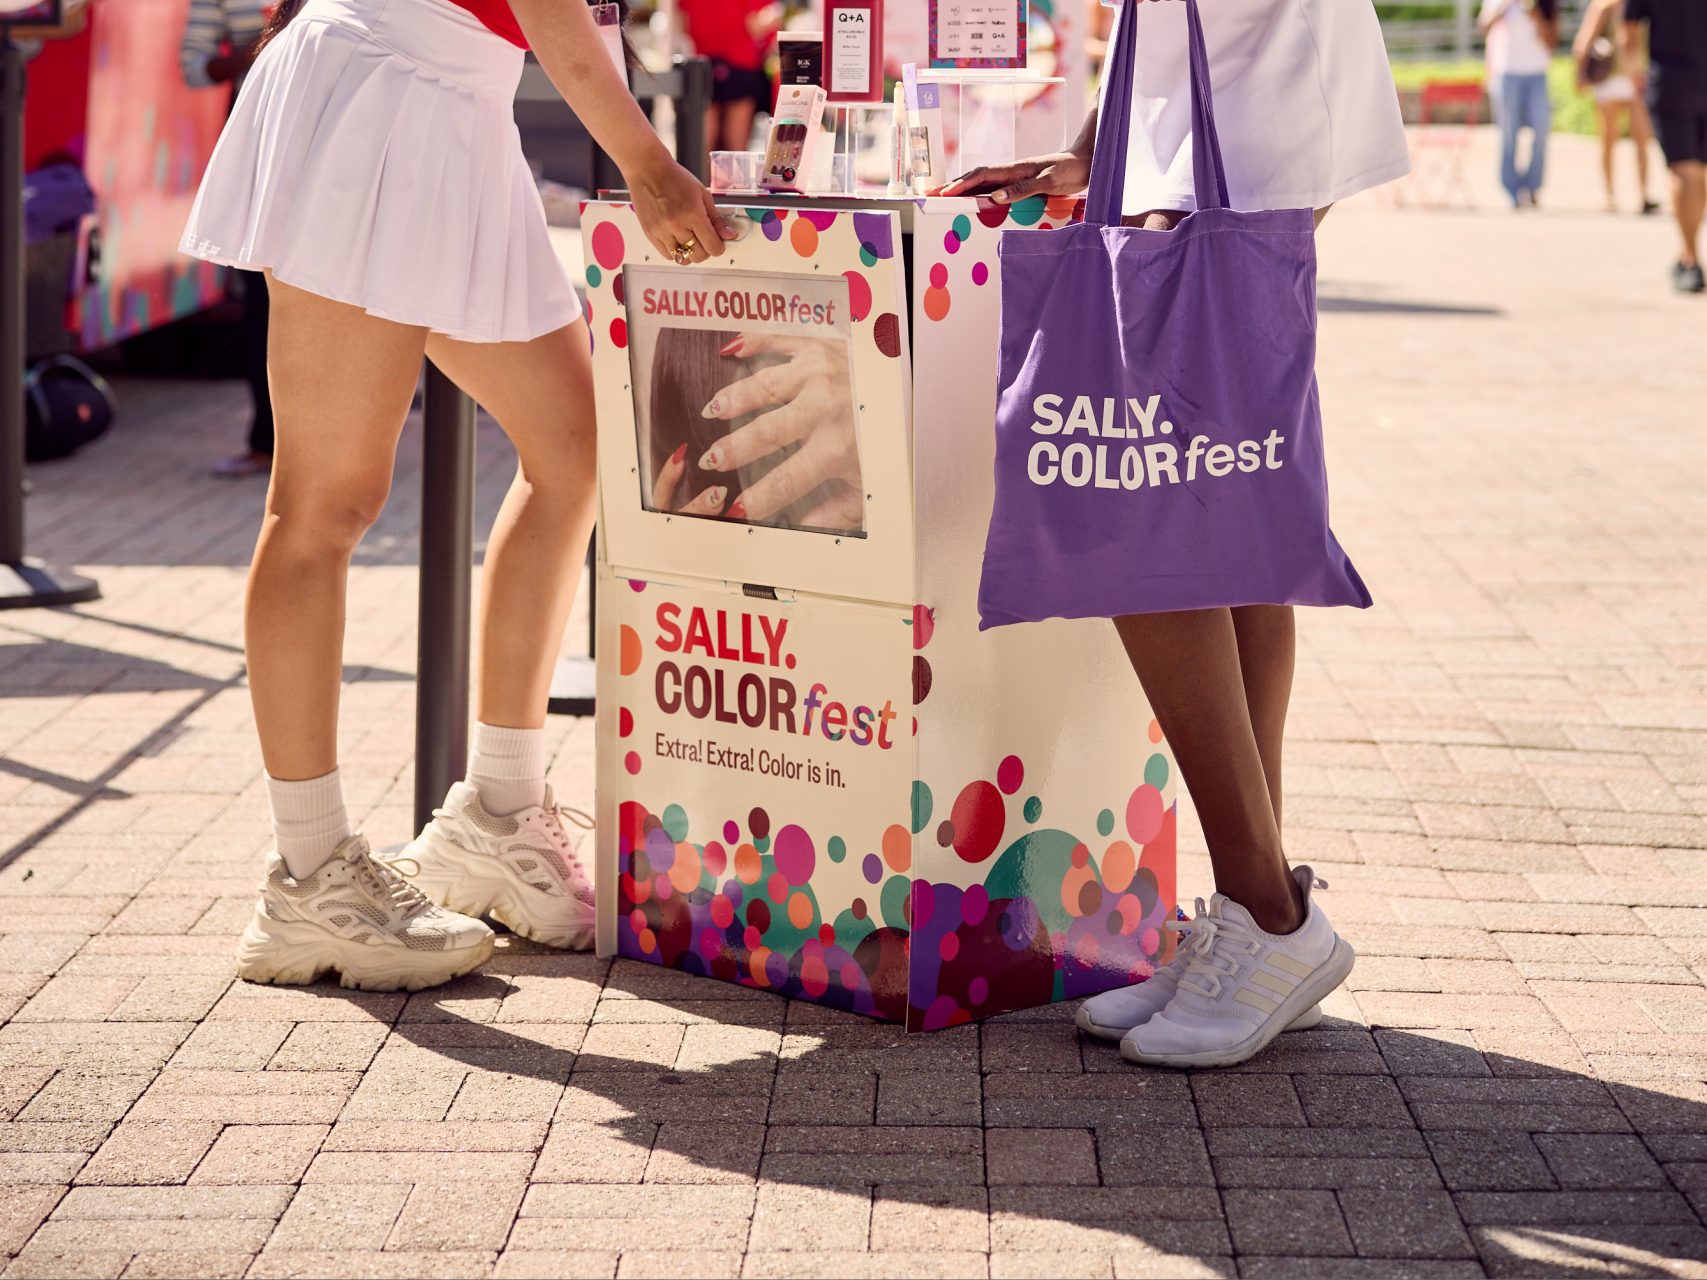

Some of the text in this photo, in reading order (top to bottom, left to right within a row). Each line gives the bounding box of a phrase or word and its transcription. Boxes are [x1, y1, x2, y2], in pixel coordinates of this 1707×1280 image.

[838, 13, 864, 23] Q+A
[1027, 428, 1285, 491] COLORfest
[655, 601, 797, 670] SALLY.
[655, 660, 898, 751] COLORfest
[655, 732, 846, 789] Extra! Extra! Color is in.
